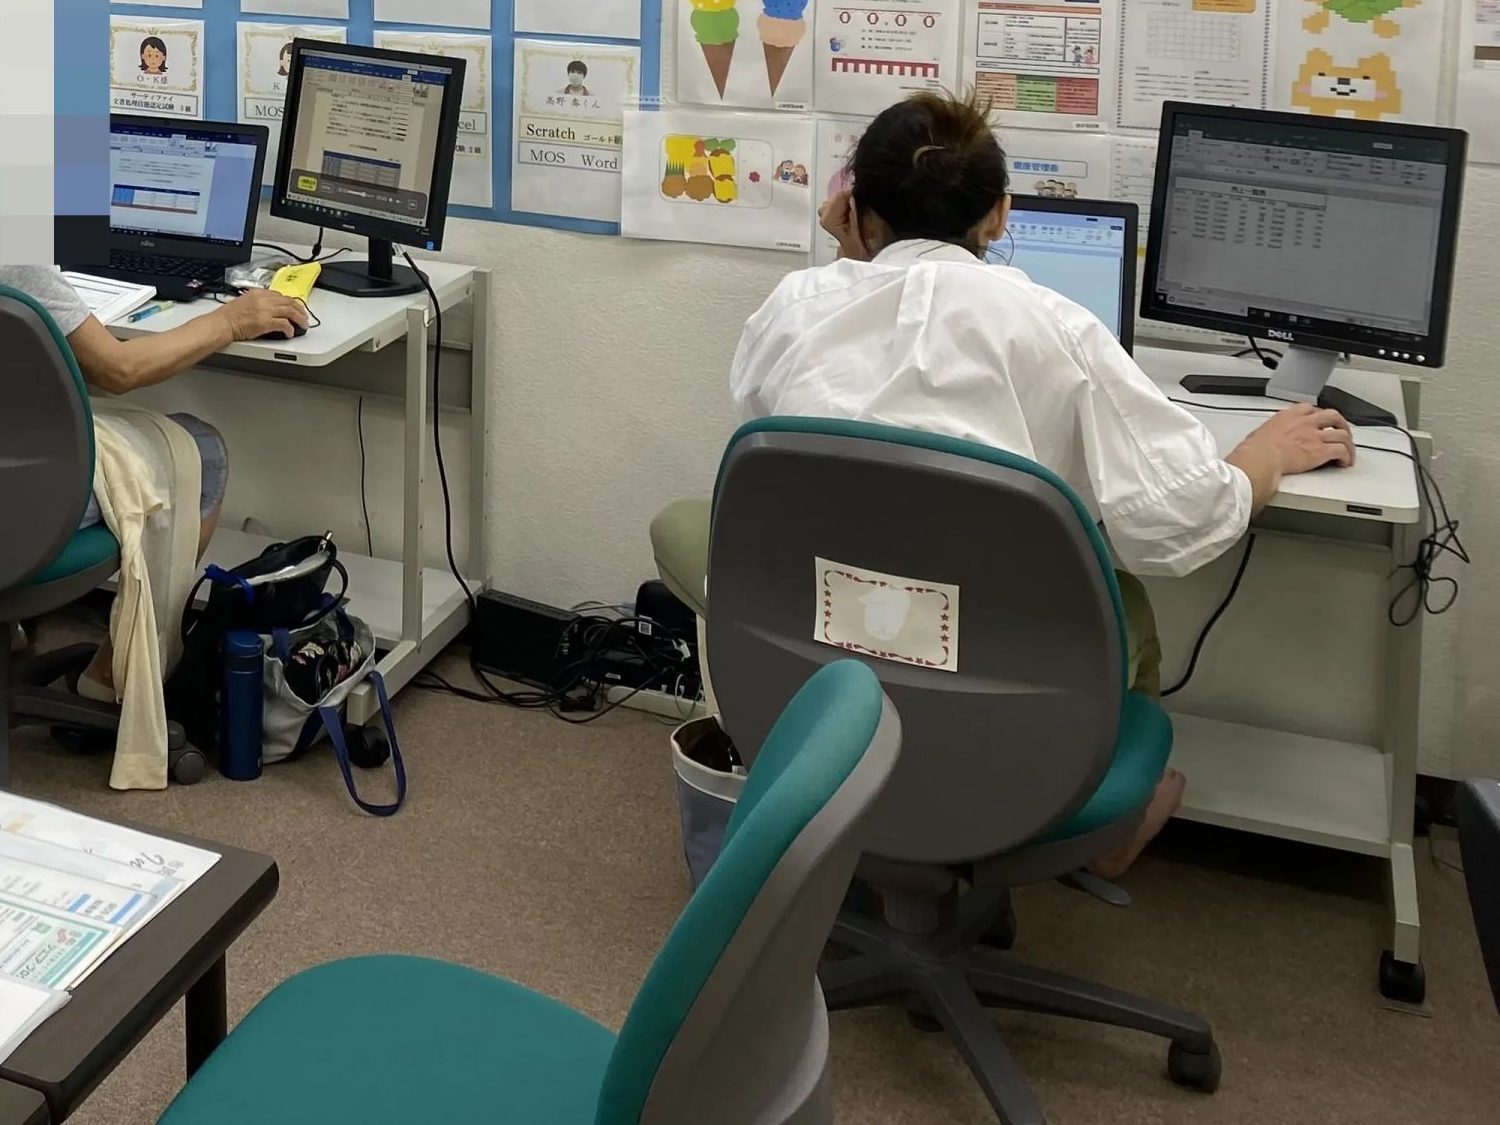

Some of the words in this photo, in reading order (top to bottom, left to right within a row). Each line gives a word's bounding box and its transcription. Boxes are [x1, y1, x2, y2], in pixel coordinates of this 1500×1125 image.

[130, 92, 174, 102] サーティファイ
[255, 104, 284, 118] MOS
[458, 119, 476, 131] cel
[526, 123, 575, 140] Scratch
[530, 149, 566, 164] MOS
[581, 154, 618, 169] Word
[1268, 329, 1295, 341] DELL
